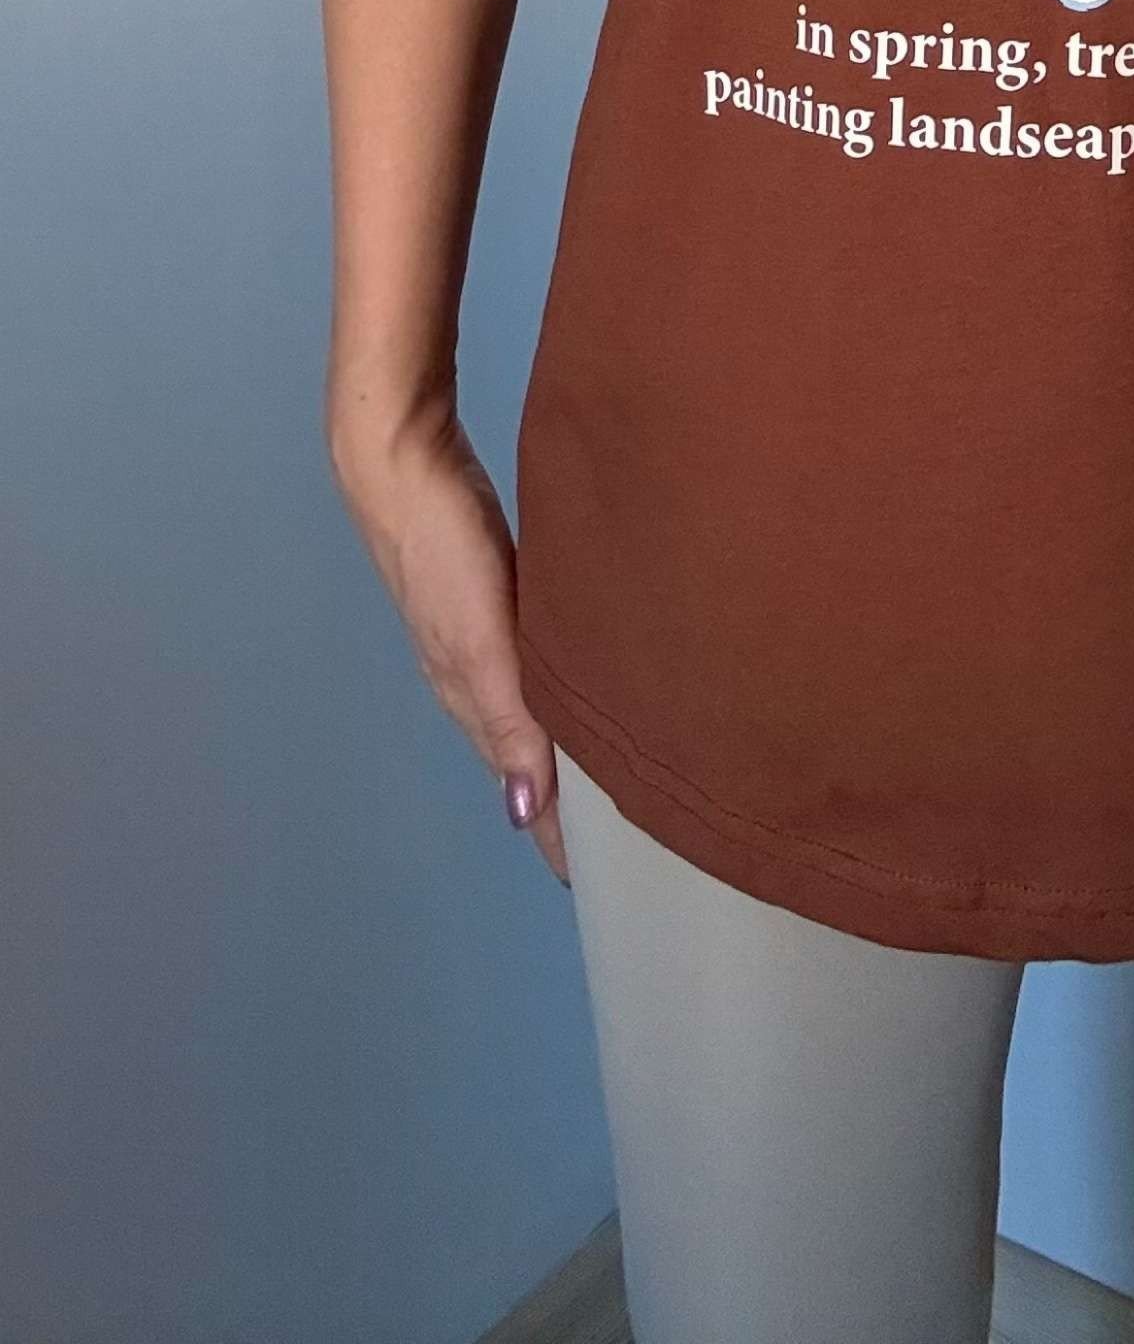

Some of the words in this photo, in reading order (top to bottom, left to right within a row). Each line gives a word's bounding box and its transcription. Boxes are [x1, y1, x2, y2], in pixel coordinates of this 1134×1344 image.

[795, 4, 835, 59] in
[848, 22, 1048, 92] spring,
[703, 68, 877, 159] painting
